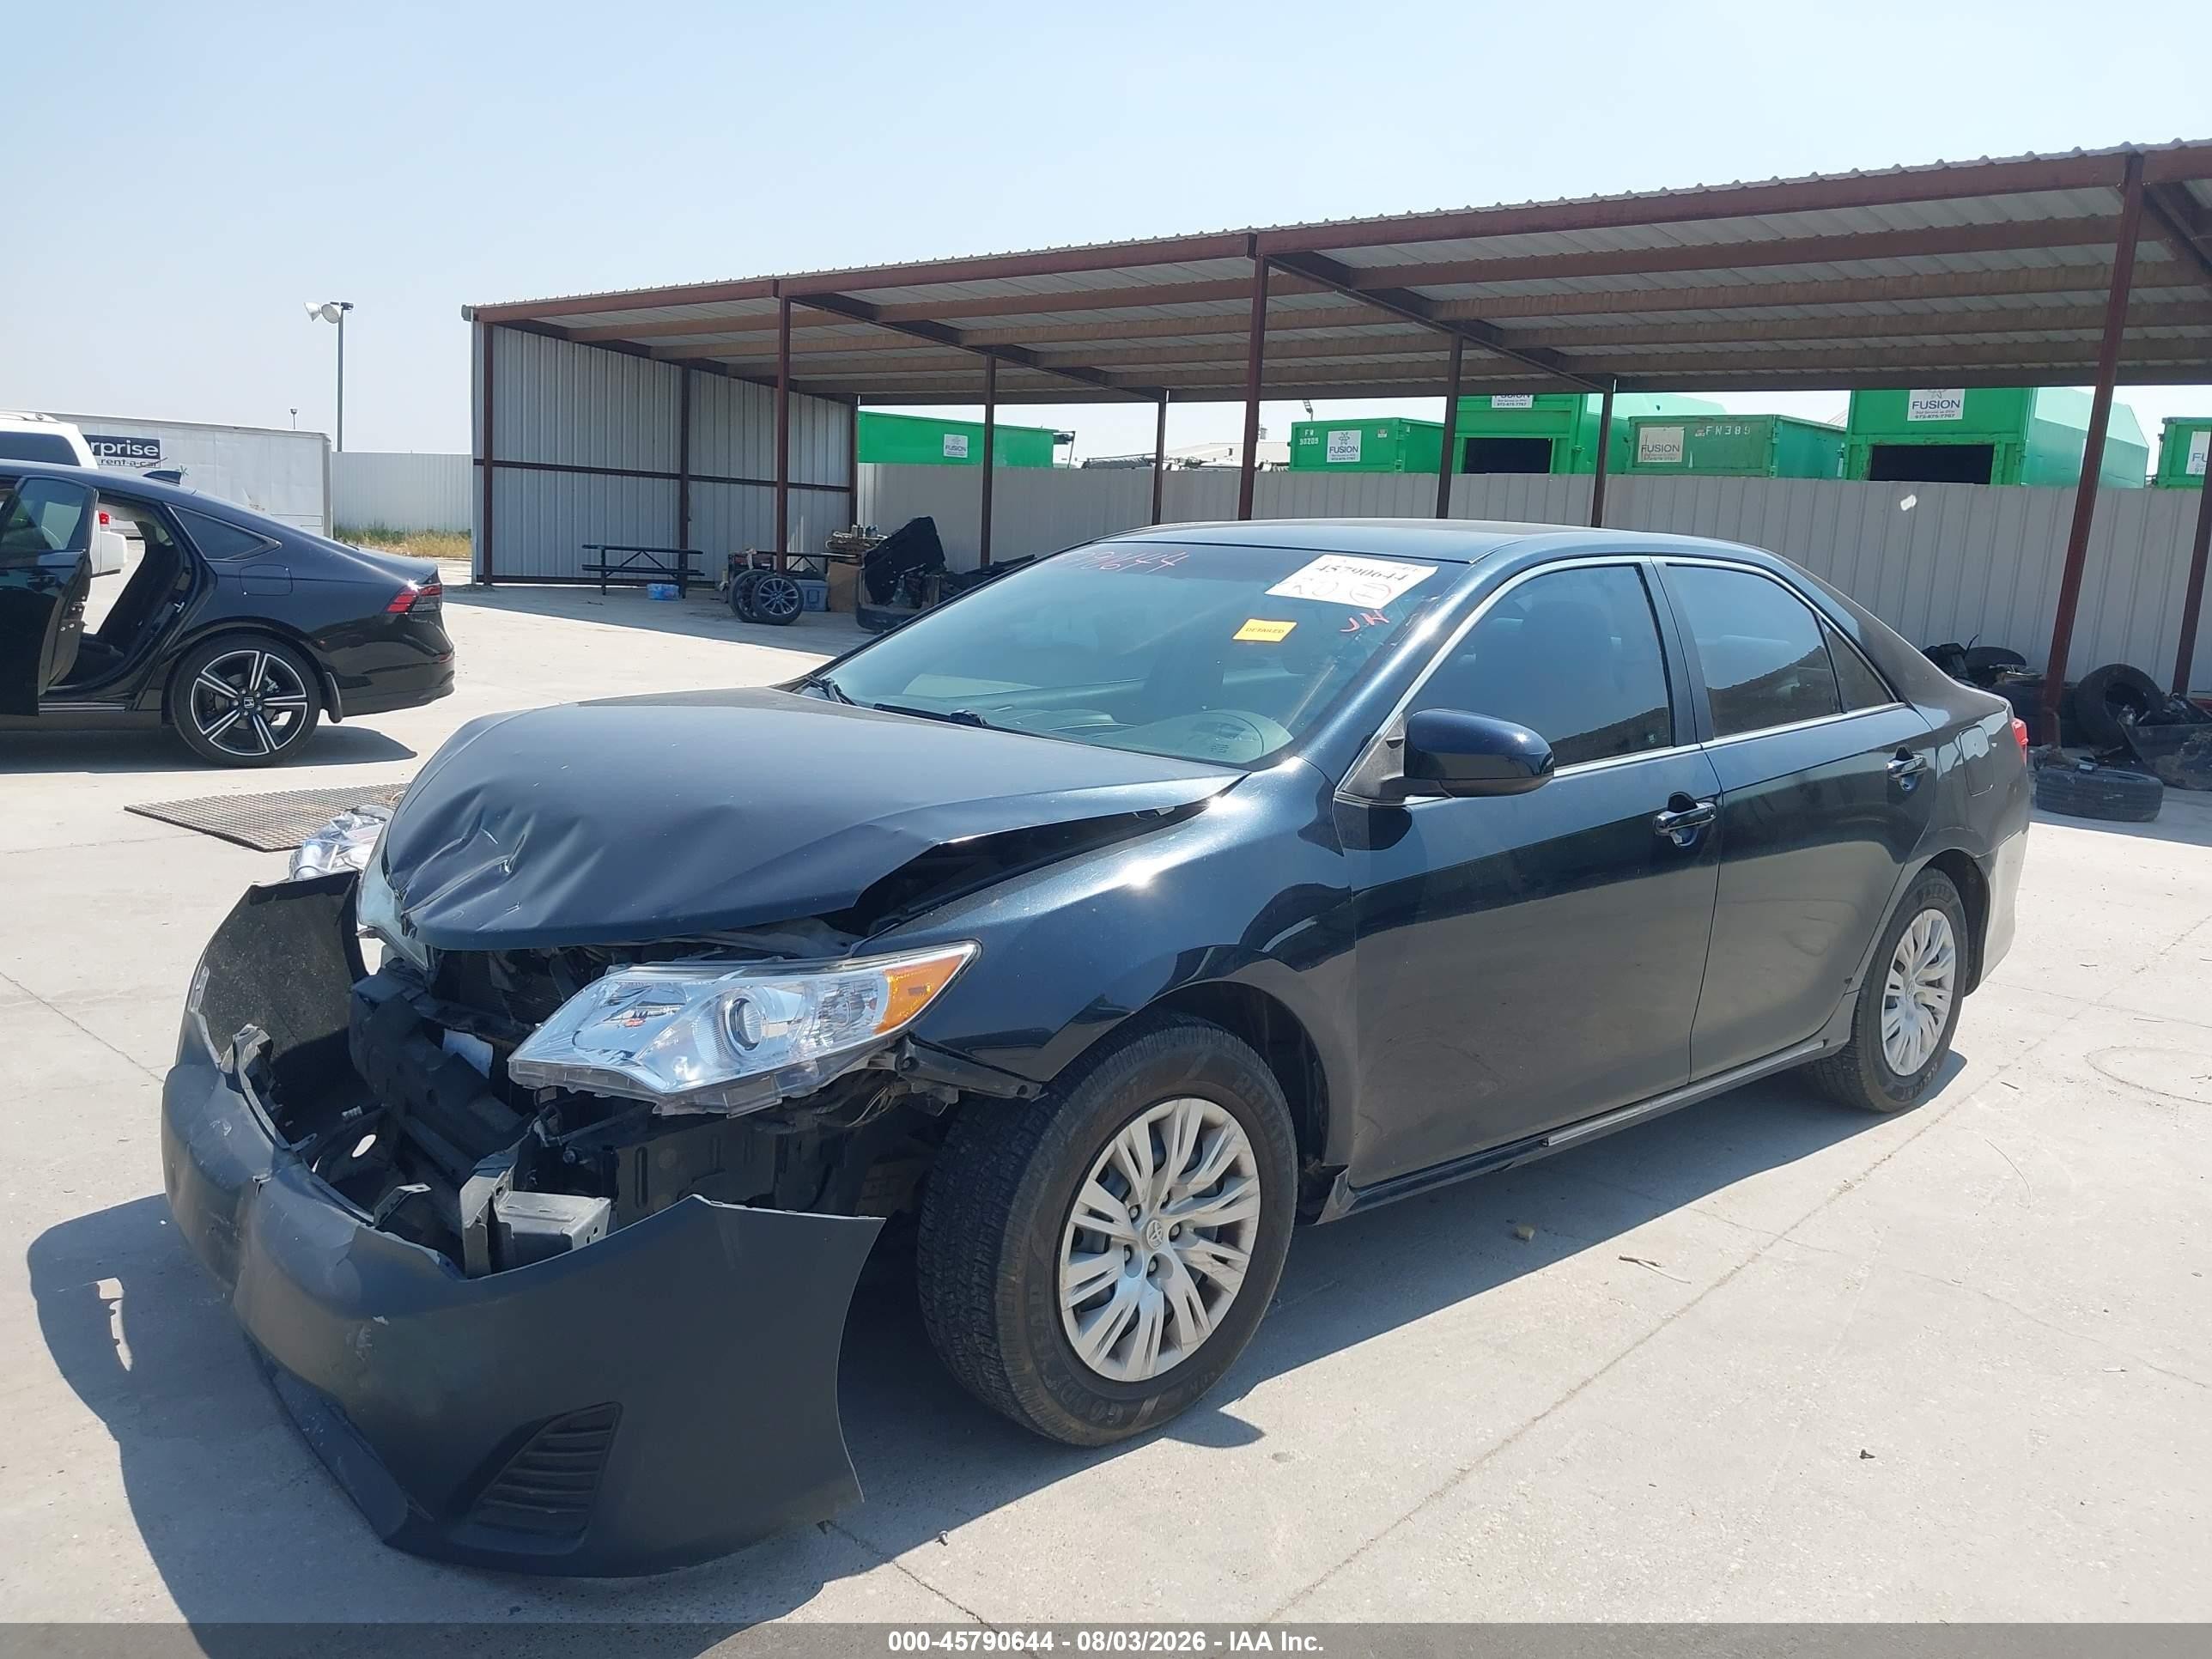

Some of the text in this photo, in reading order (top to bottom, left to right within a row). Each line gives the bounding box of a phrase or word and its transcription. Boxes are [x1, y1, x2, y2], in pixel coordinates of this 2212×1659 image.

[1911, 399, 1960, 410] FUSION
[90, 440, 159, 457] rprise
[1641, 443, 1680, 453] FUSION
